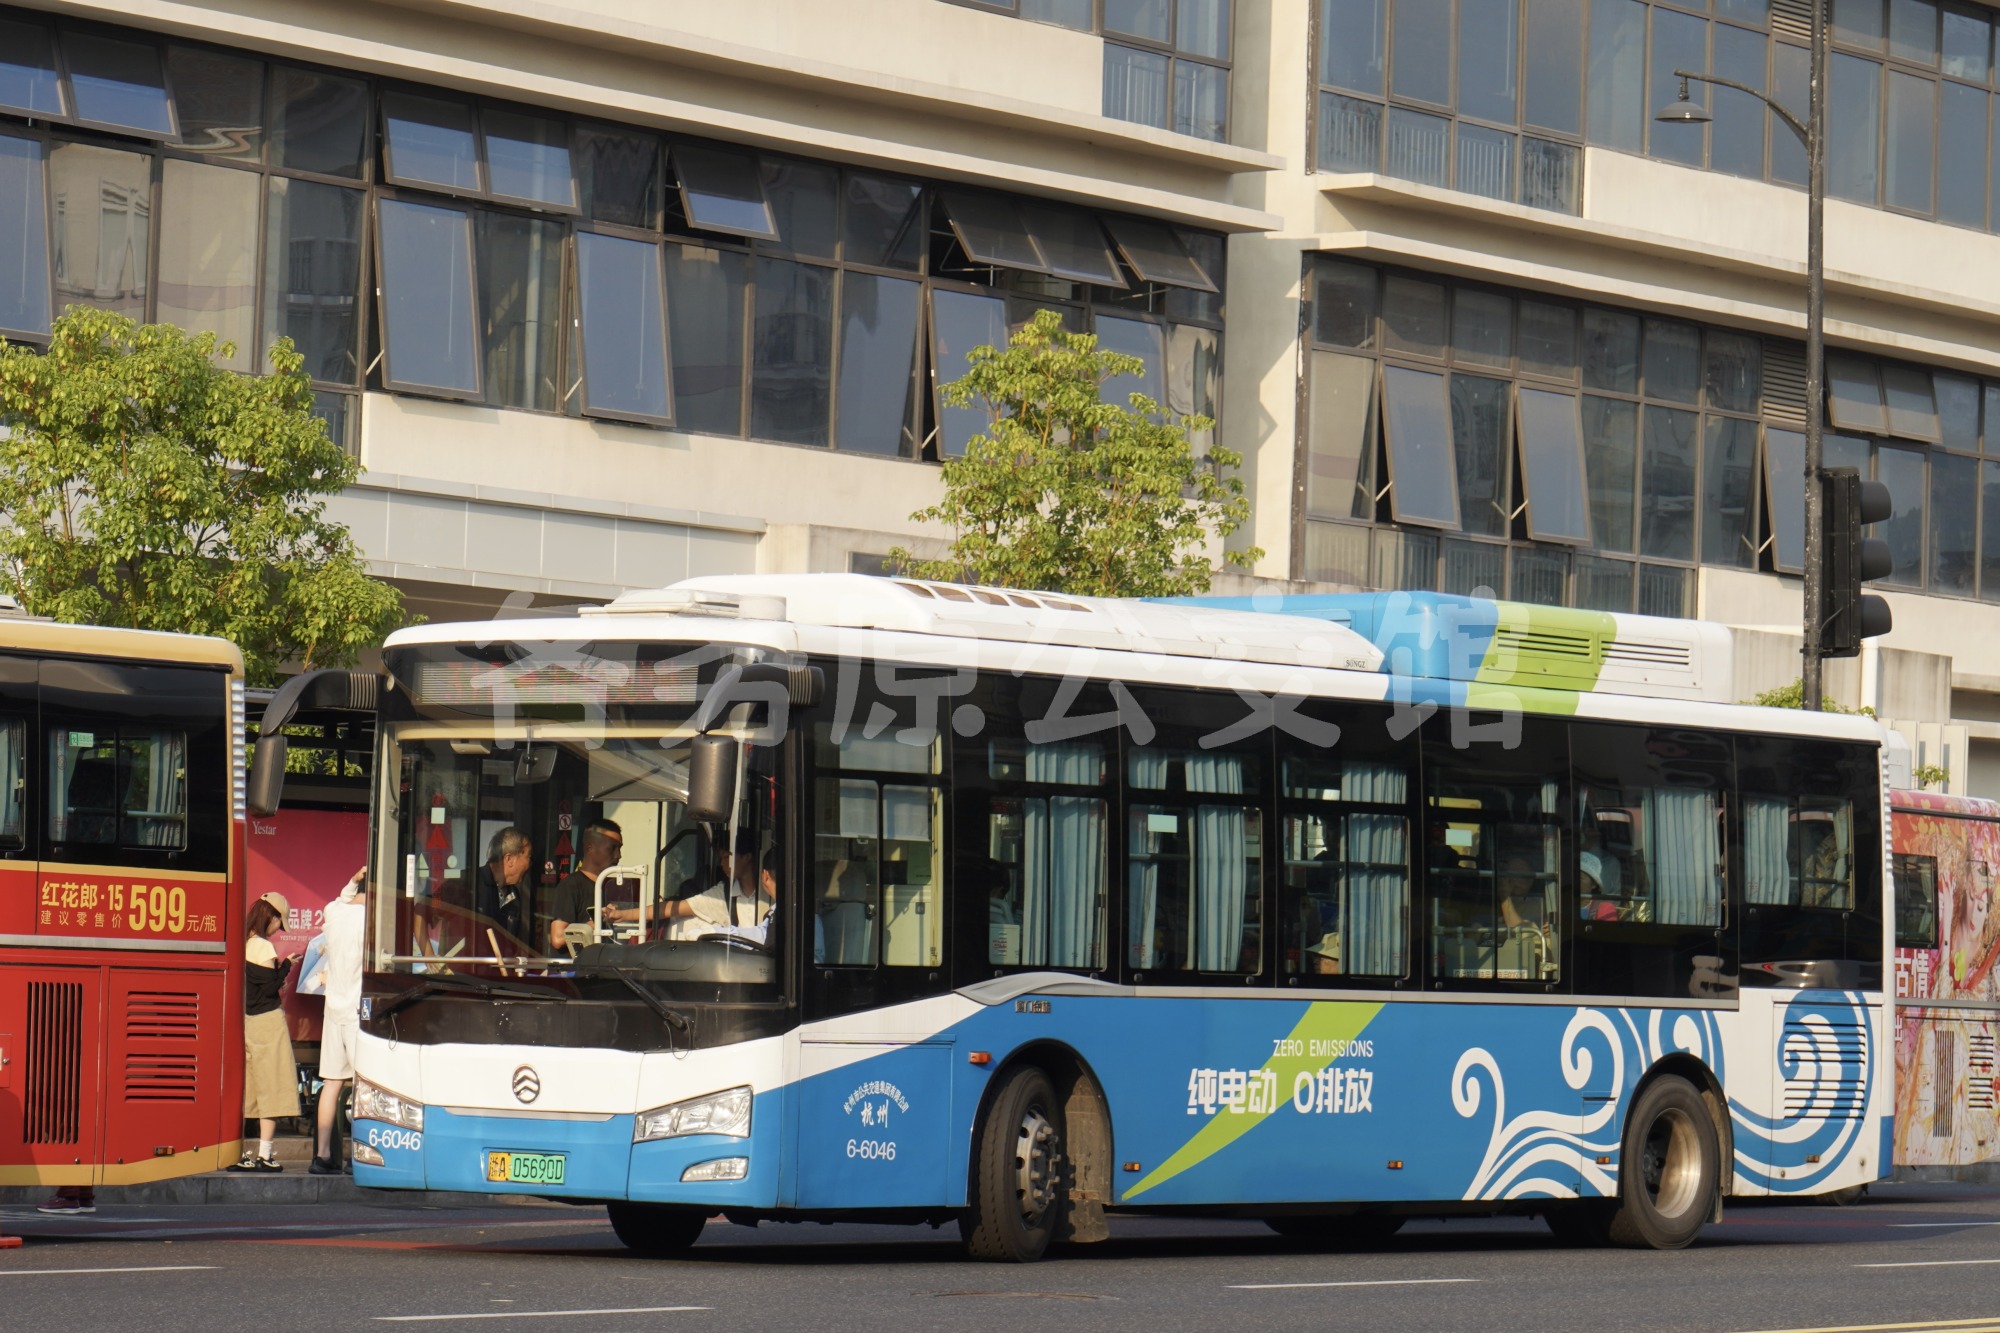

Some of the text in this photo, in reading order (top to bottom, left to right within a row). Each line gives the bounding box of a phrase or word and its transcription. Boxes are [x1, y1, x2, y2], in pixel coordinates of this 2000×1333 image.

[1345, 659, 1367, 669] SONGZ
[252, 821, 277, 836] Yestar
[41, 881, 124, 911] 红花郎·15
[40, 884, 218, 933] 建议零售价 599 元/瓶
[1273, 1039, 1374, 1058] ZERO EMISSIONS
[1186, 1068, 1374, 1115] 纯电动 0排放
[860, 1098, 889, 1129] 杭州
[368, 1128, 422, 1151] 6-6046
[846, 1138, 897, 1161] 6-6046
[513, 1157, 564, 1180] 05690D
